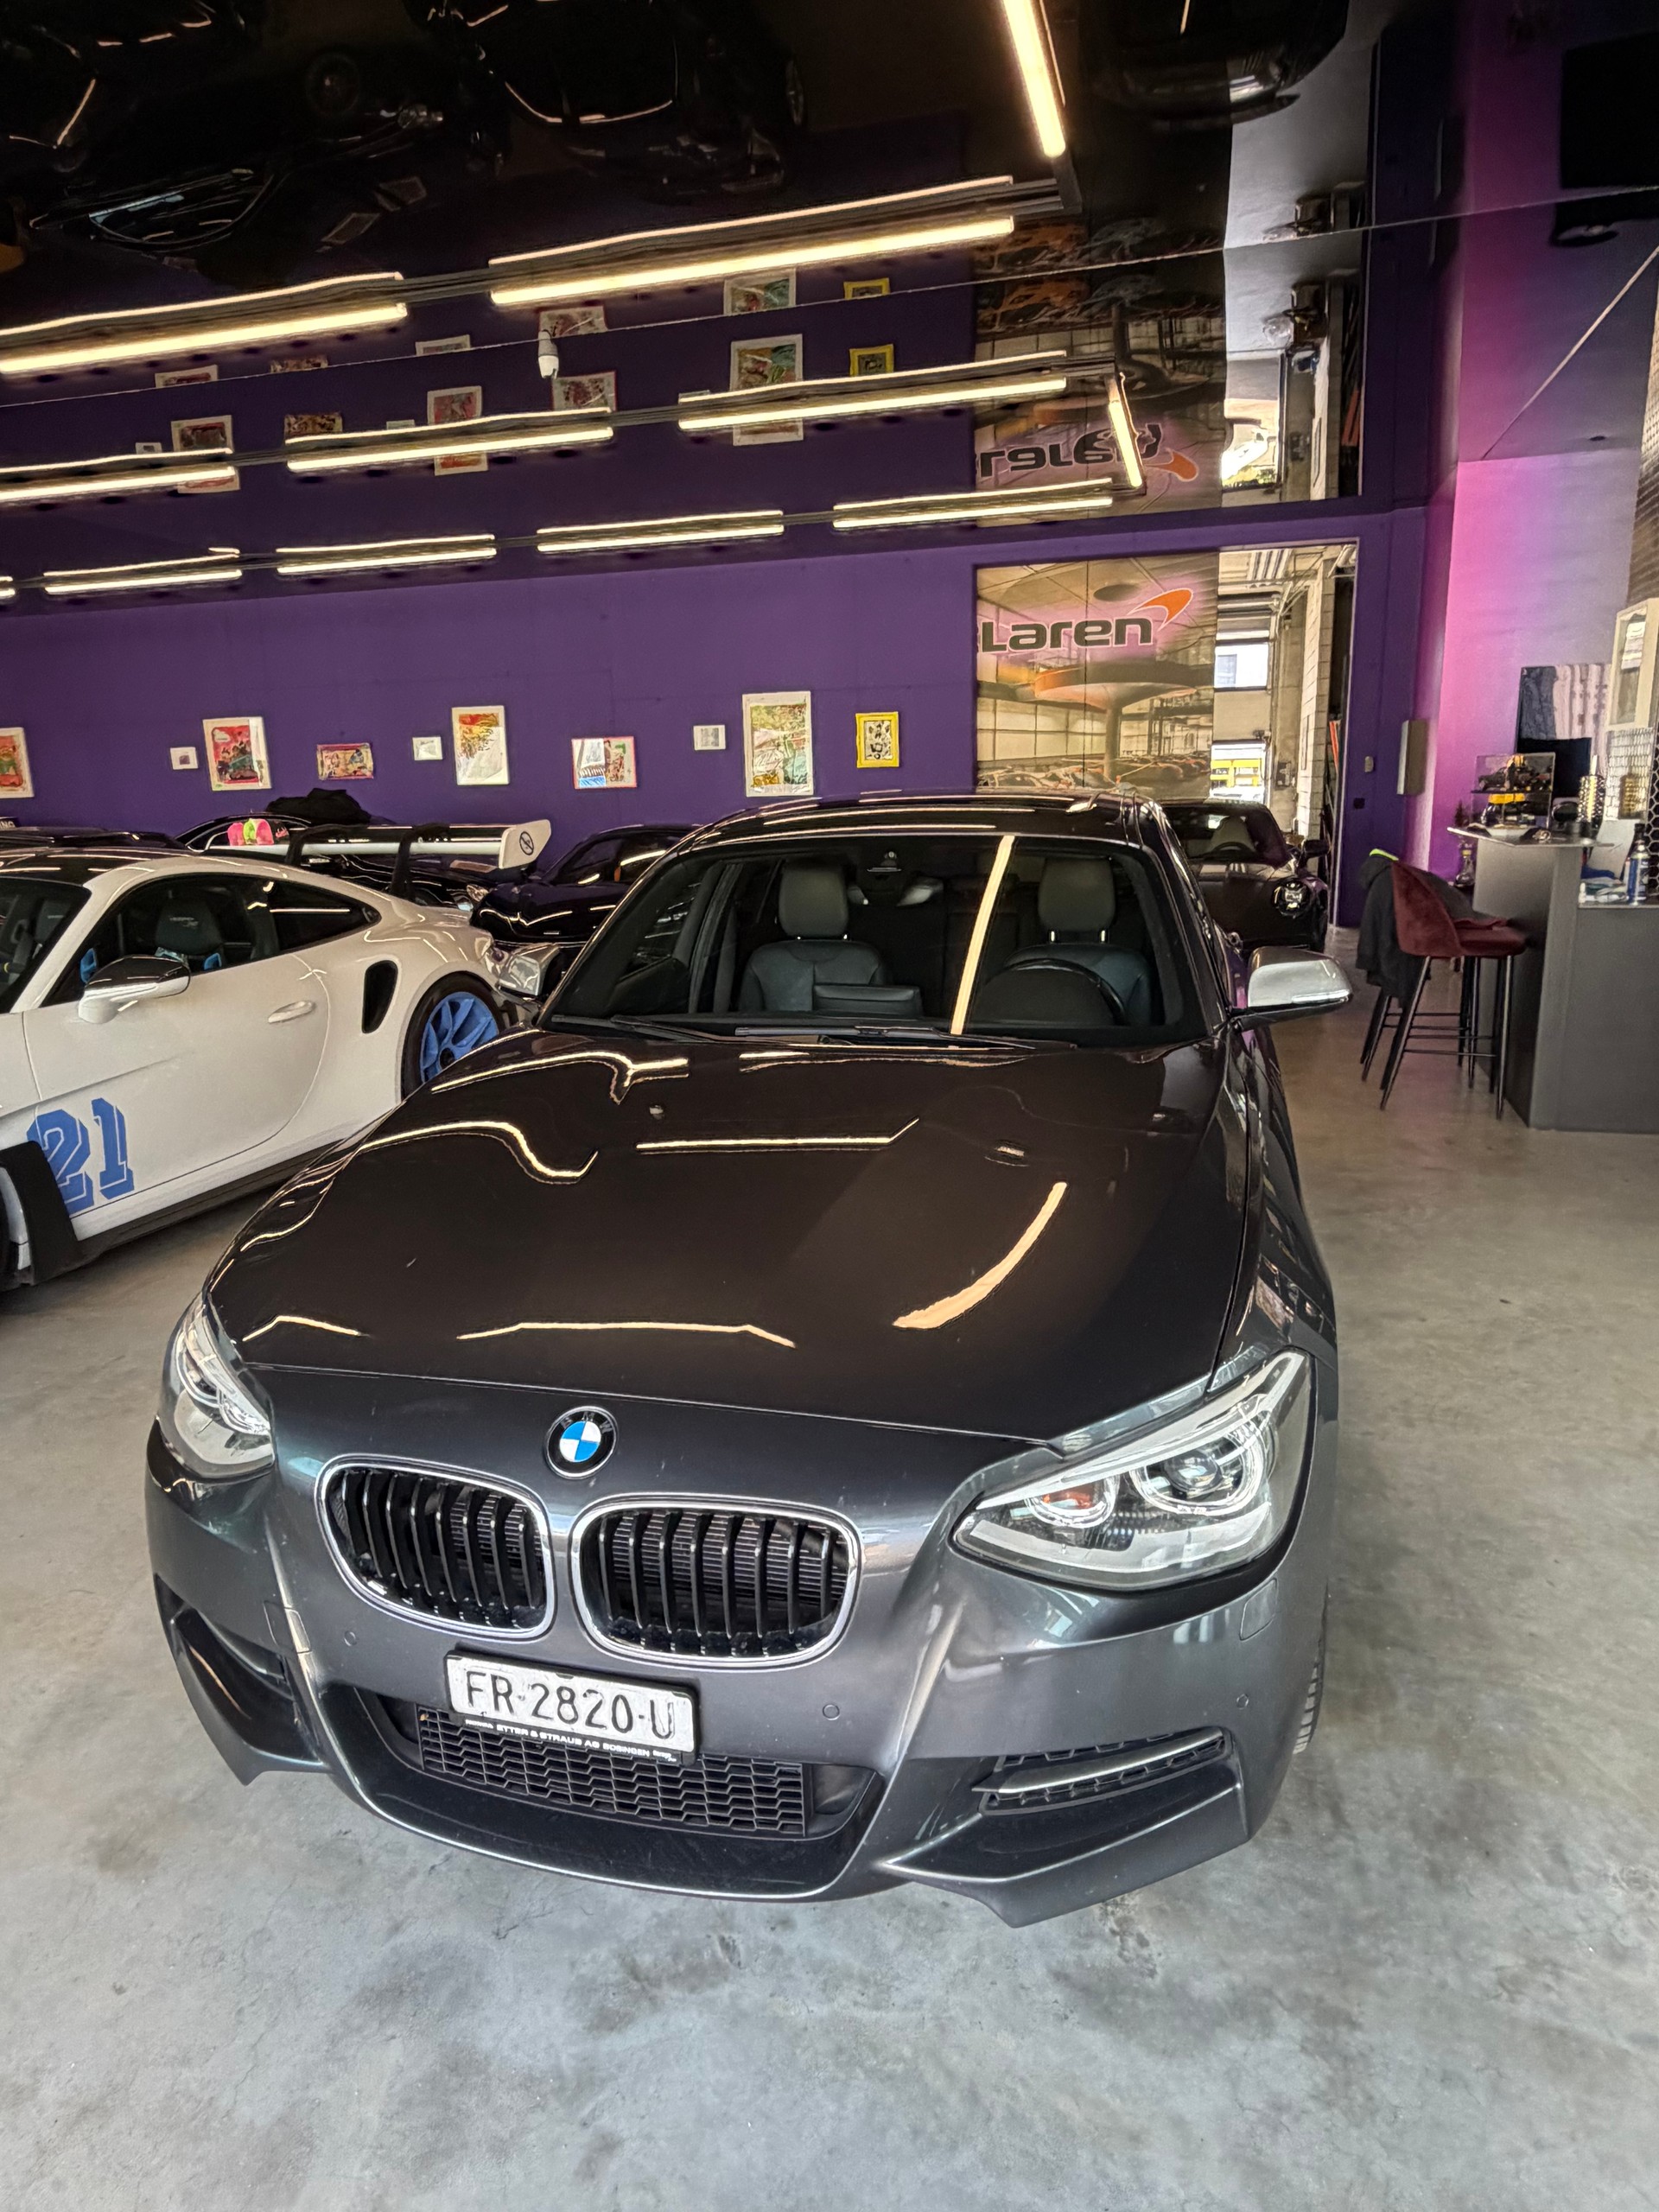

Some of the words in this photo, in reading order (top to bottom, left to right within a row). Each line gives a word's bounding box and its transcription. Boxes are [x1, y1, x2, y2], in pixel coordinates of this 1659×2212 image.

[981, 617, 1154, 653] Laren
[26, 1096, 135, 1216] 21
[559, 1411, 613, 1434] BMW
